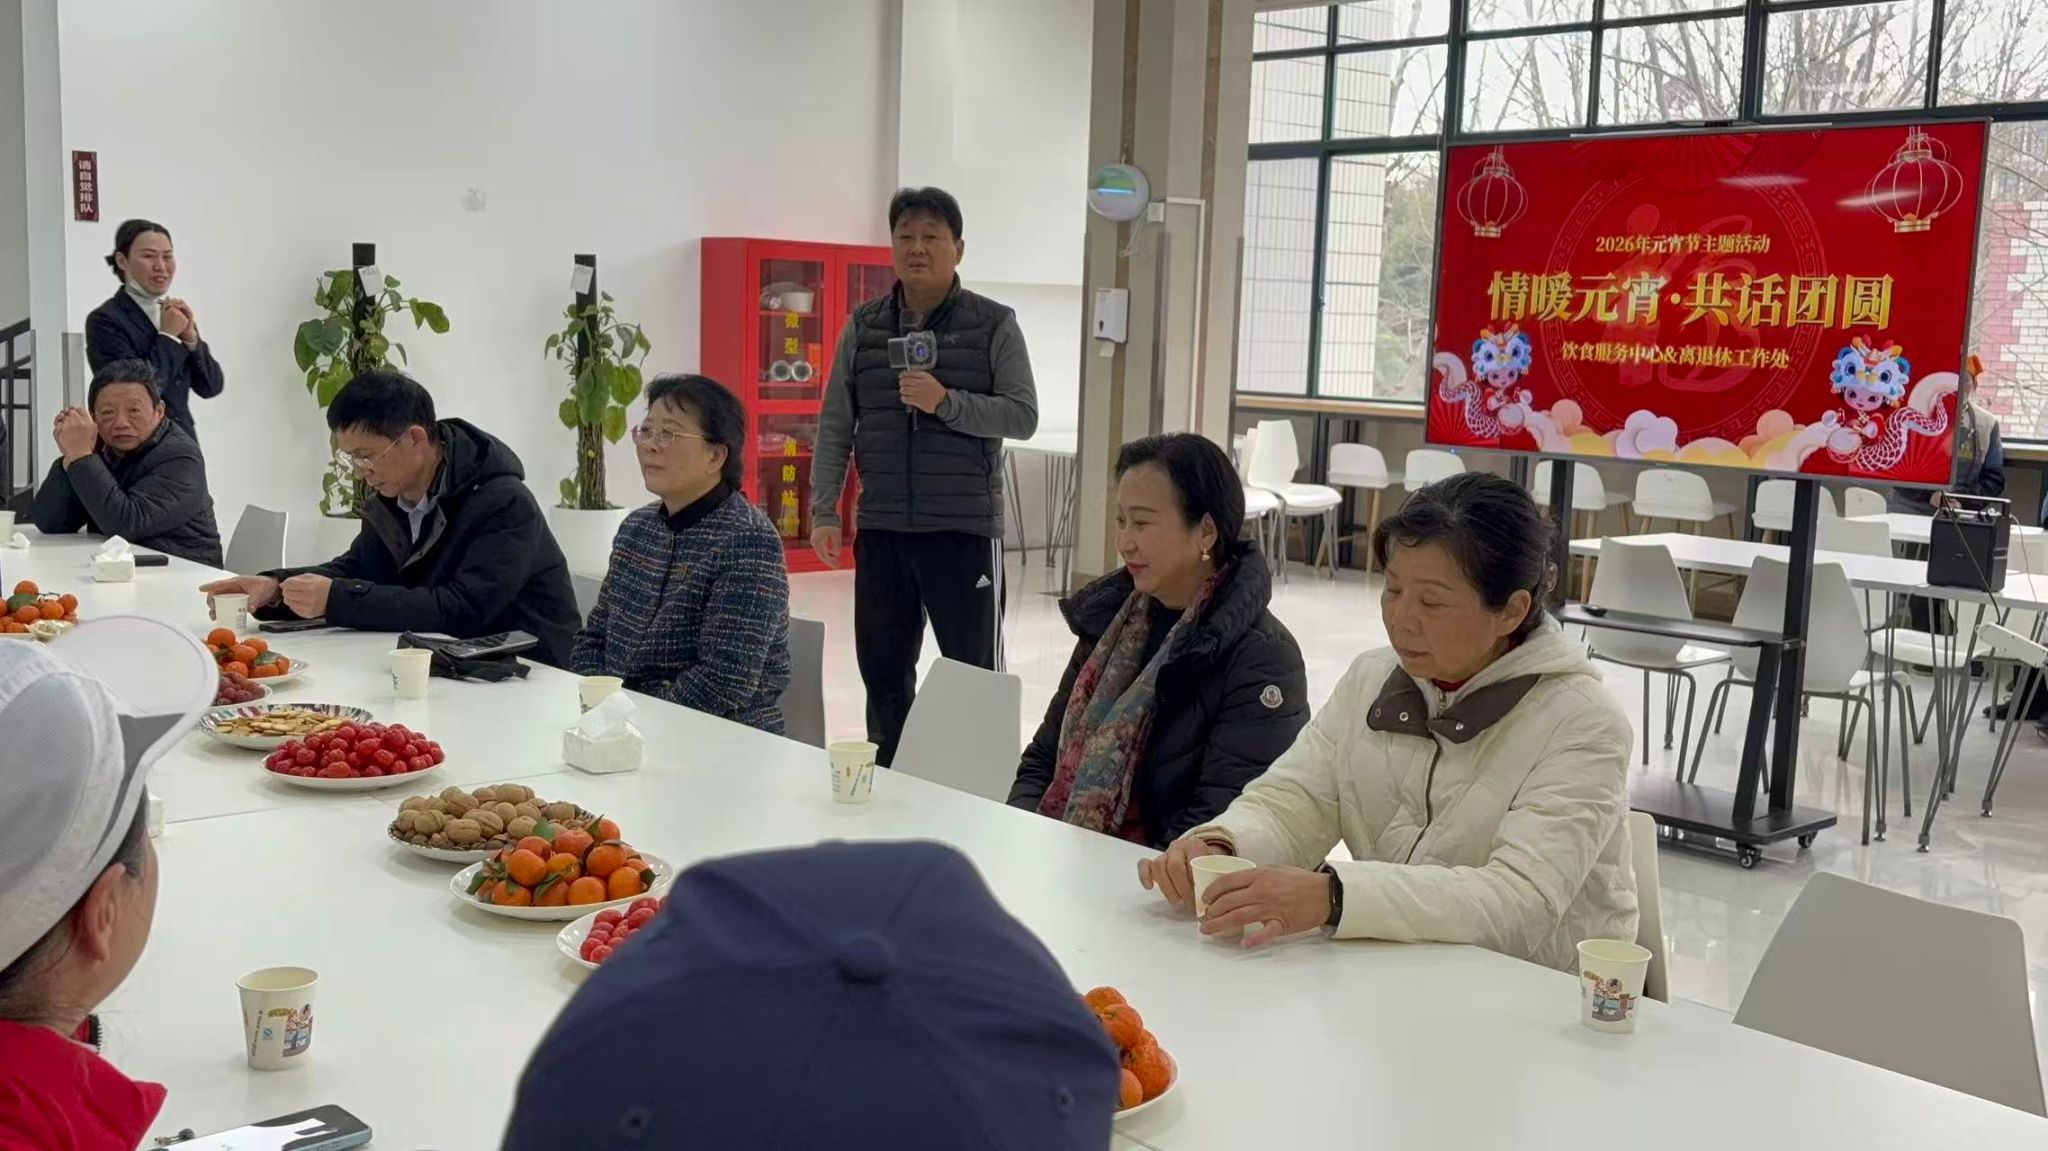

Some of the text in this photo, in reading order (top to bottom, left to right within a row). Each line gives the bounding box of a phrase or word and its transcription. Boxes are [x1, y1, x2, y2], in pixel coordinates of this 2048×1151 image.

[78, 160, 93, 213] 请自觉排队
[1595, 233, 1771, 255] 2026年元宵节主题活动
[1487, 270, 1894, 330] 情暖元宵·共话团圆
[783, 311, 799, 355] 微型
[1561, 340, 1790, 369] 饮食服务中心&离退休工作处
